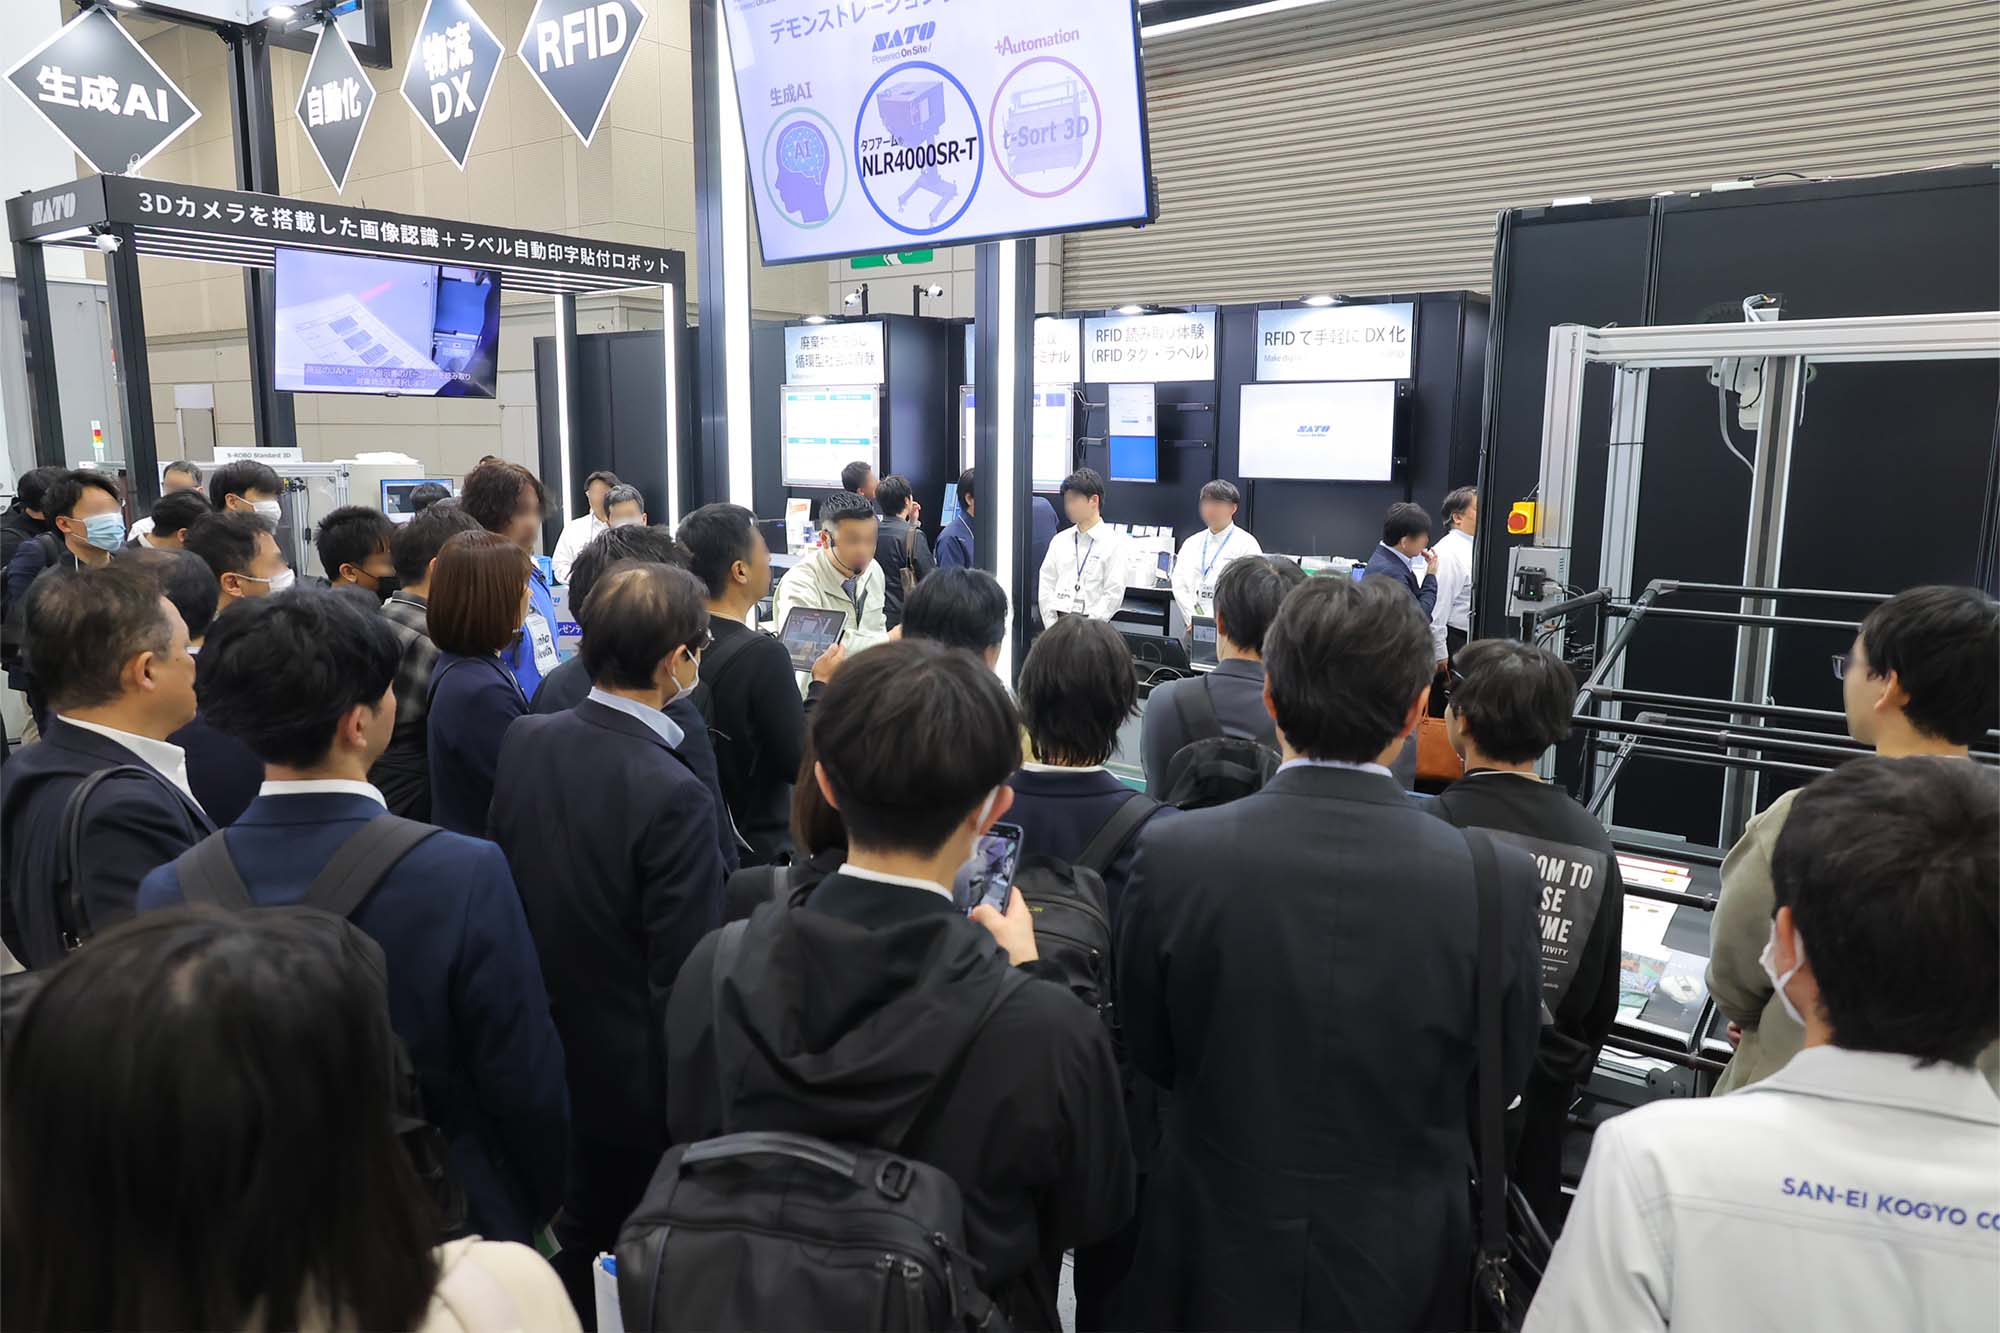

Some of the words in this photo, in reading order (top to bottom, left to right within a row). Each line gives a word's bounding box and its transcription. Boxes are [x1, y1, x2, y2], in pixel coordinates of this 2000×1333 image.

[422, 20, 474, 80] 物流
[536, 1, 627, 73] RFID
[872, 21, 936, 53] SATO
[36, 64, 169, 123] 生成AI
[307, 77, 362, 127] 自動化
[430, 71, 476, 125] DX
[770, 81, 813, 107] 生成AI
[795, 141, 811, 159] AI
[1003, 120, 1057, 150] t-Sort
[1063, 115, 1090, 140] 3D
[862, 137, 977, 178] NLR4000SR-T
[31, 192, 76, 227] SATO
[1095, 328, 1122, 343] RFID
[1264, 330, 1296, 347] RFID
[1365, 327, 1385, 343] DX
[1389, 325, 1406, 343] 化
[1529, 853, 1566, 883] OM
[1570, 861, 1593, 890] TO
[1538, 914, 1573, 943] IME
[1781, 1177, 1868, 1209] SAN-EI
[1876, 1194, 1967, 1226] KOGYO
